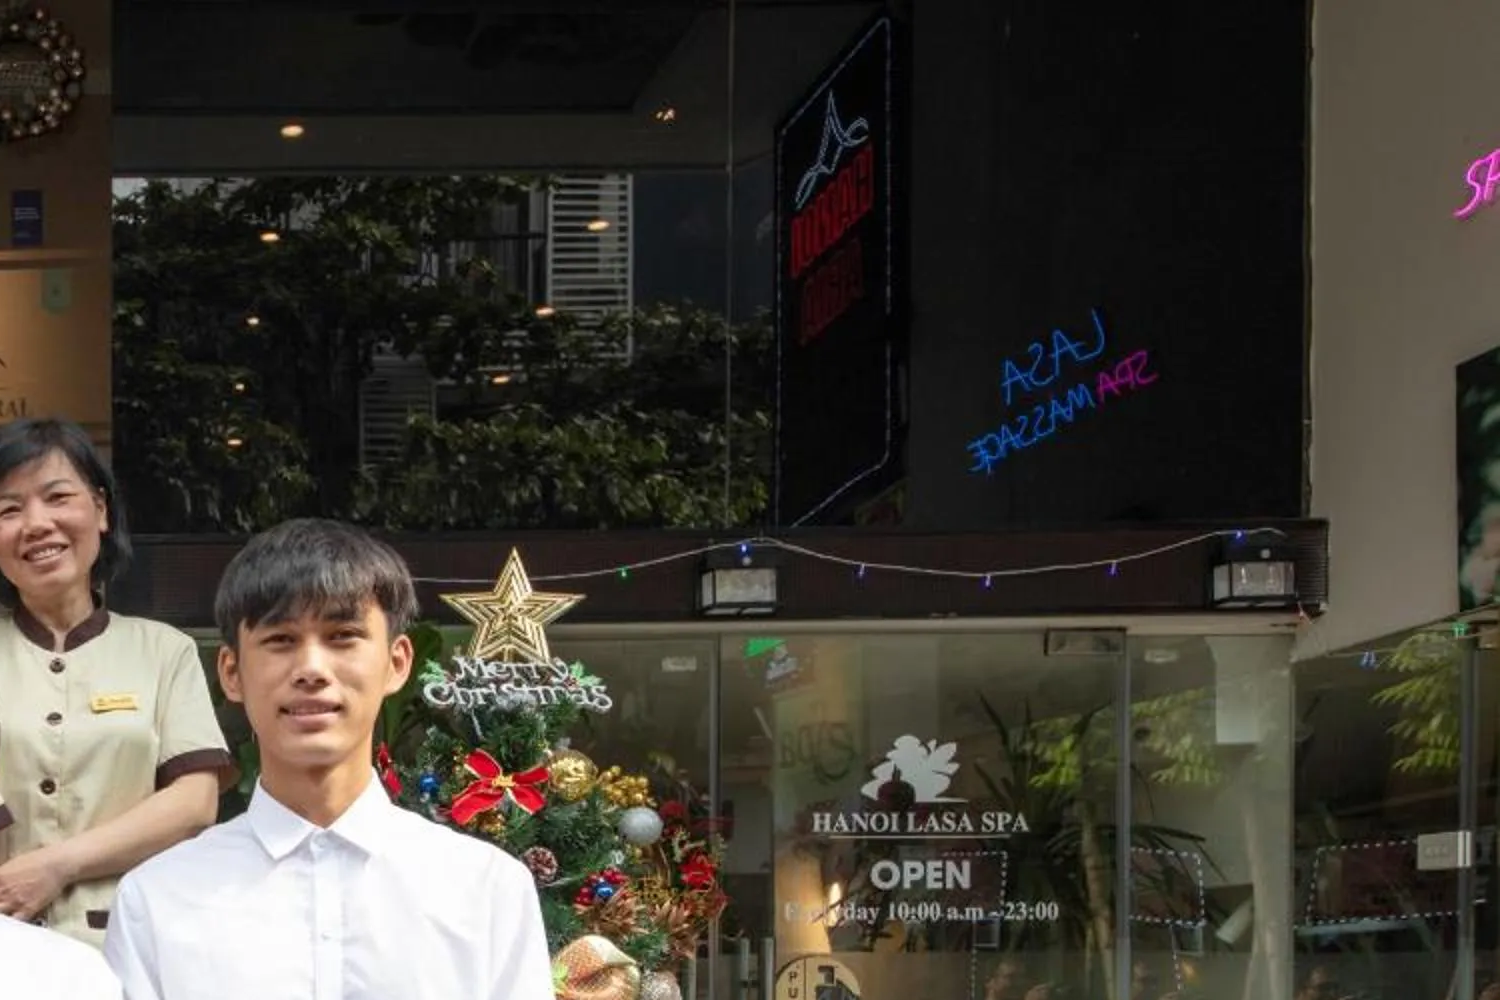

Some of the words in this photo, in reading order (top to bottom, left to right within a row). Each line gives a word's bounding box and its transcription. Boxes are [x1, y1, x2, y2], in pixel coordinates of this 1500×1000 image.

[451, 655, 570, 682] Merry
[423, 681, 614, 711] Christmas
[811, 811, 900, 833] HANOI
[906, 811, 975, 833] LASA
[980, 811, 1030, 833] SPA
[870, 859, 972, 890] OPEN
[887, 902, 941, 921] 10:00
[1003, 902, 1060, 921] 23:00
